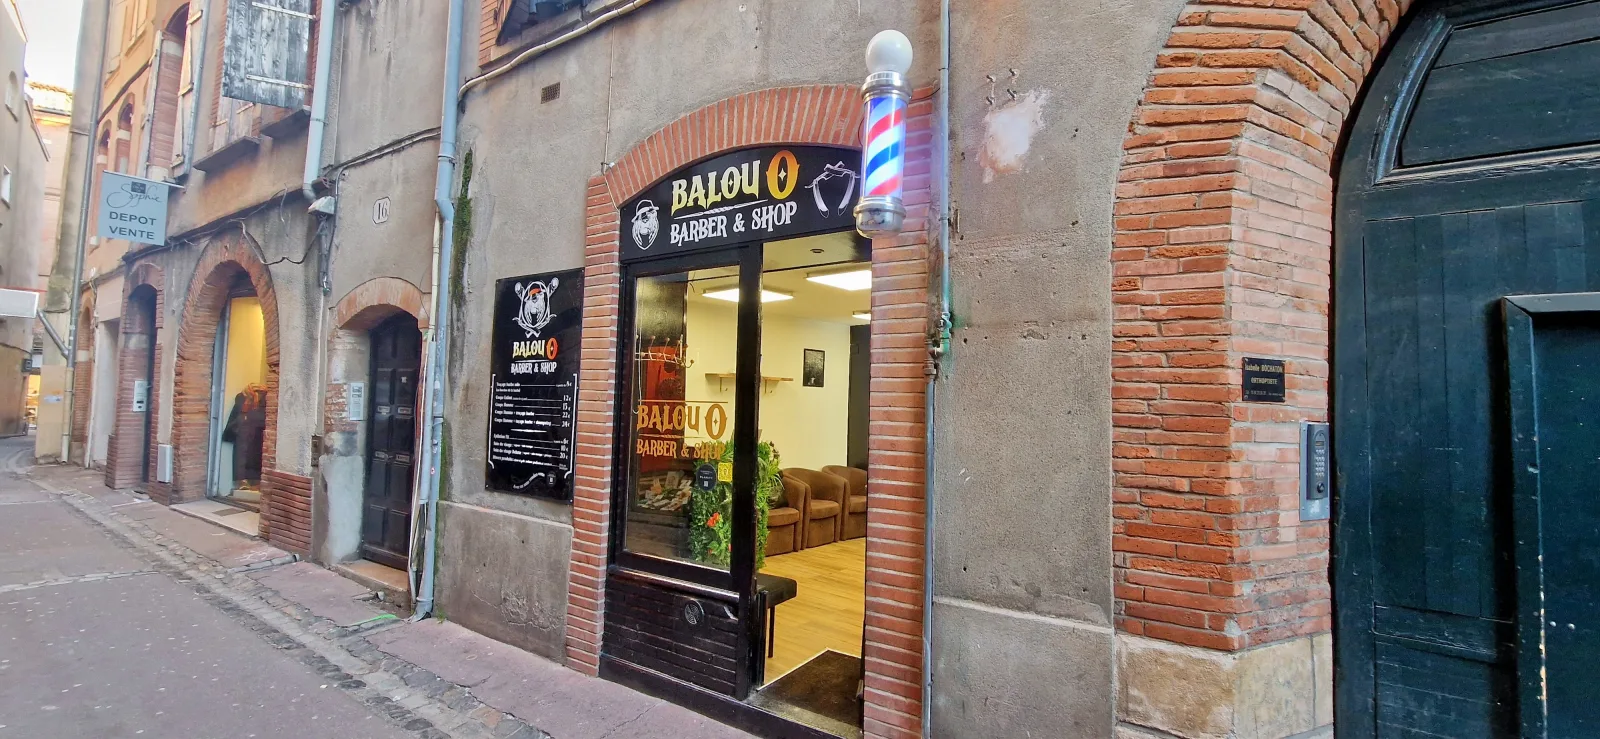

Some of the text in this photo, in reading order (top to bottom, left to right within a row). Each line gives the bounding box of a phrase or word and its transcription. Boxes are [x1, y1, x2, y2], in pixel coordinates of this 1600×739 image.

[670, 149, 800, 216] BALOU O
[109, 211, 157, 226] DEPOT
[377, 201, 388, 220] 16
[109, 225, 155, 240] VENTE
[670, 200, 798, 247] BARBER & SHOP
[512, 339, 545, 359] BALOU
[510, 362, 557, 375] BARBER & SHOP
[636, 403, 728, 440] BALOU O
[636, 438, 727, 463] BARBER & SHOP
